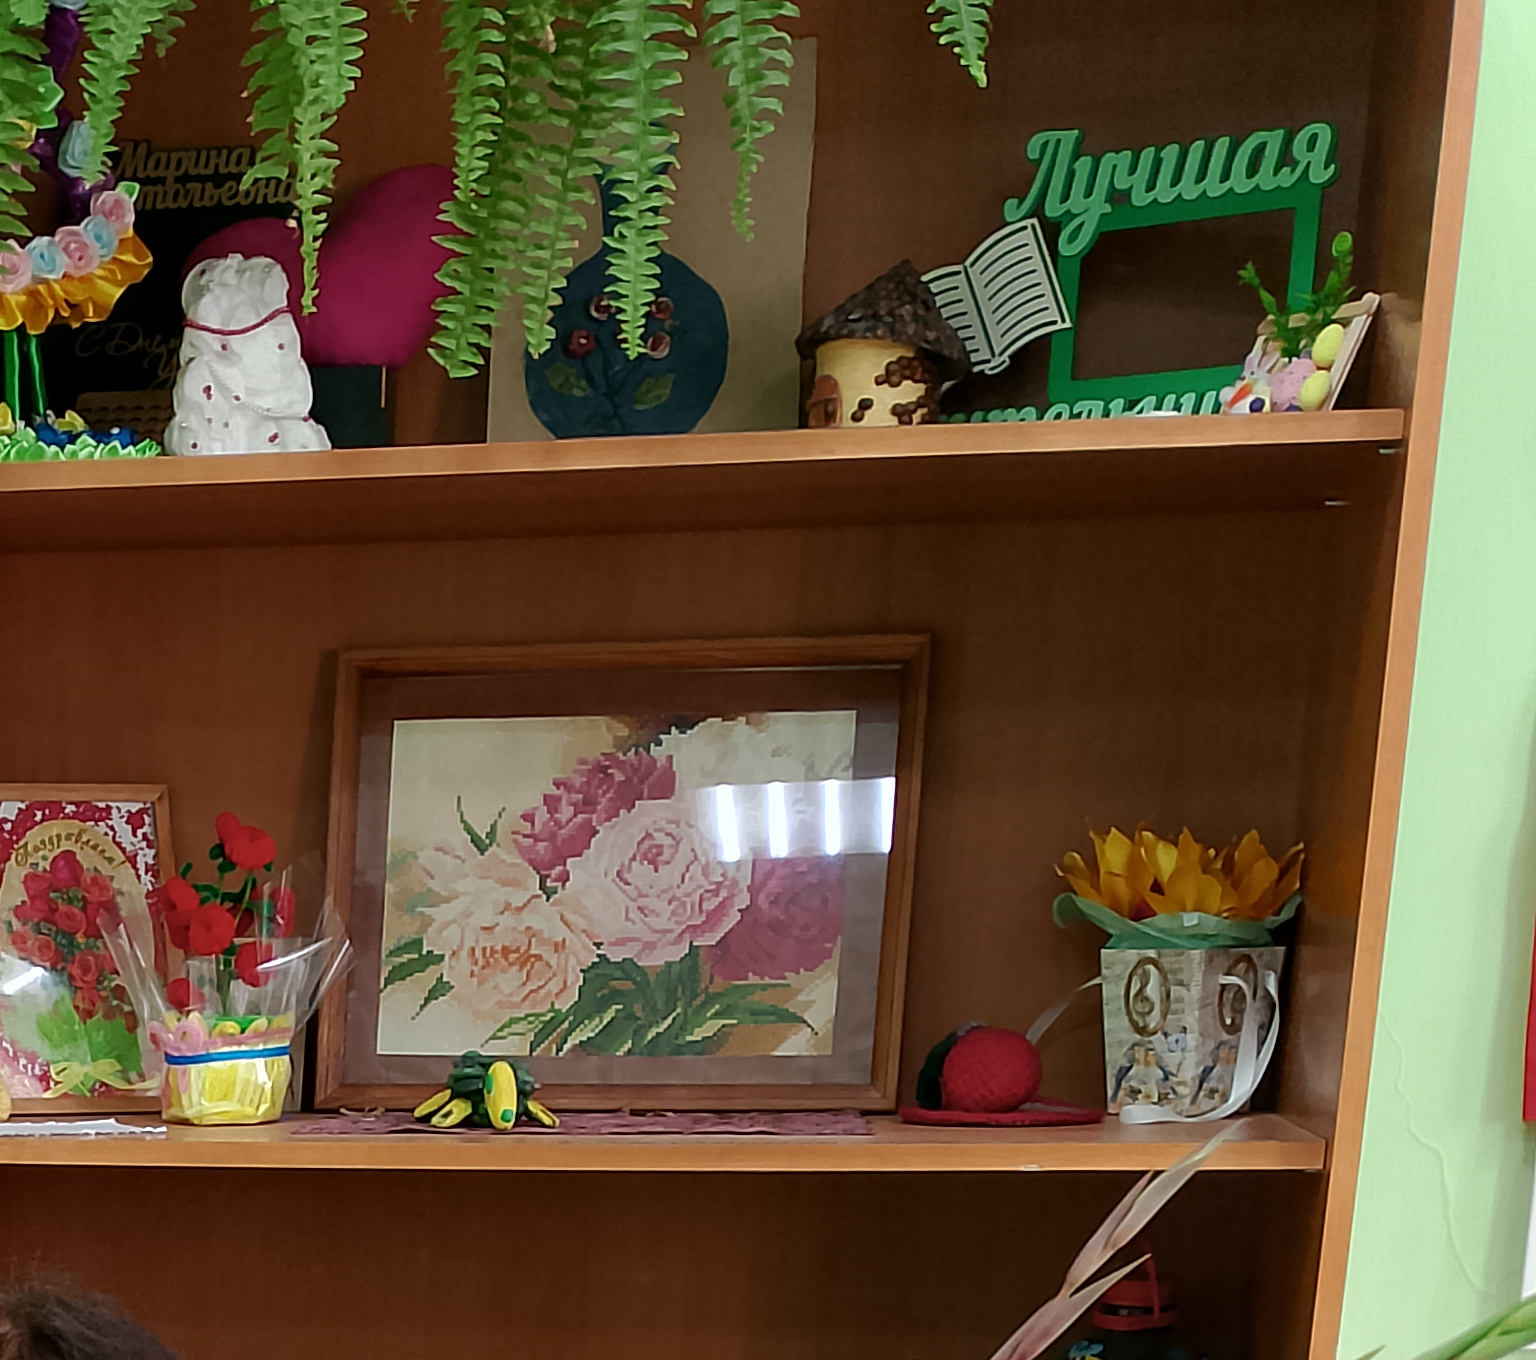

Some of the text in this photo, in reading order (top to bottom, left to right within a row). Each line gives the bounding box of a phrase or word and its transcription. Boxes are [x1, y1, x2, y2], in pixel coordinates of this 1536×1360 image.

[116, 141, 251, 187] Марина
[136, 178, 298, 211] тольевна
[1004, 122, 1340, 257] Лучшая
